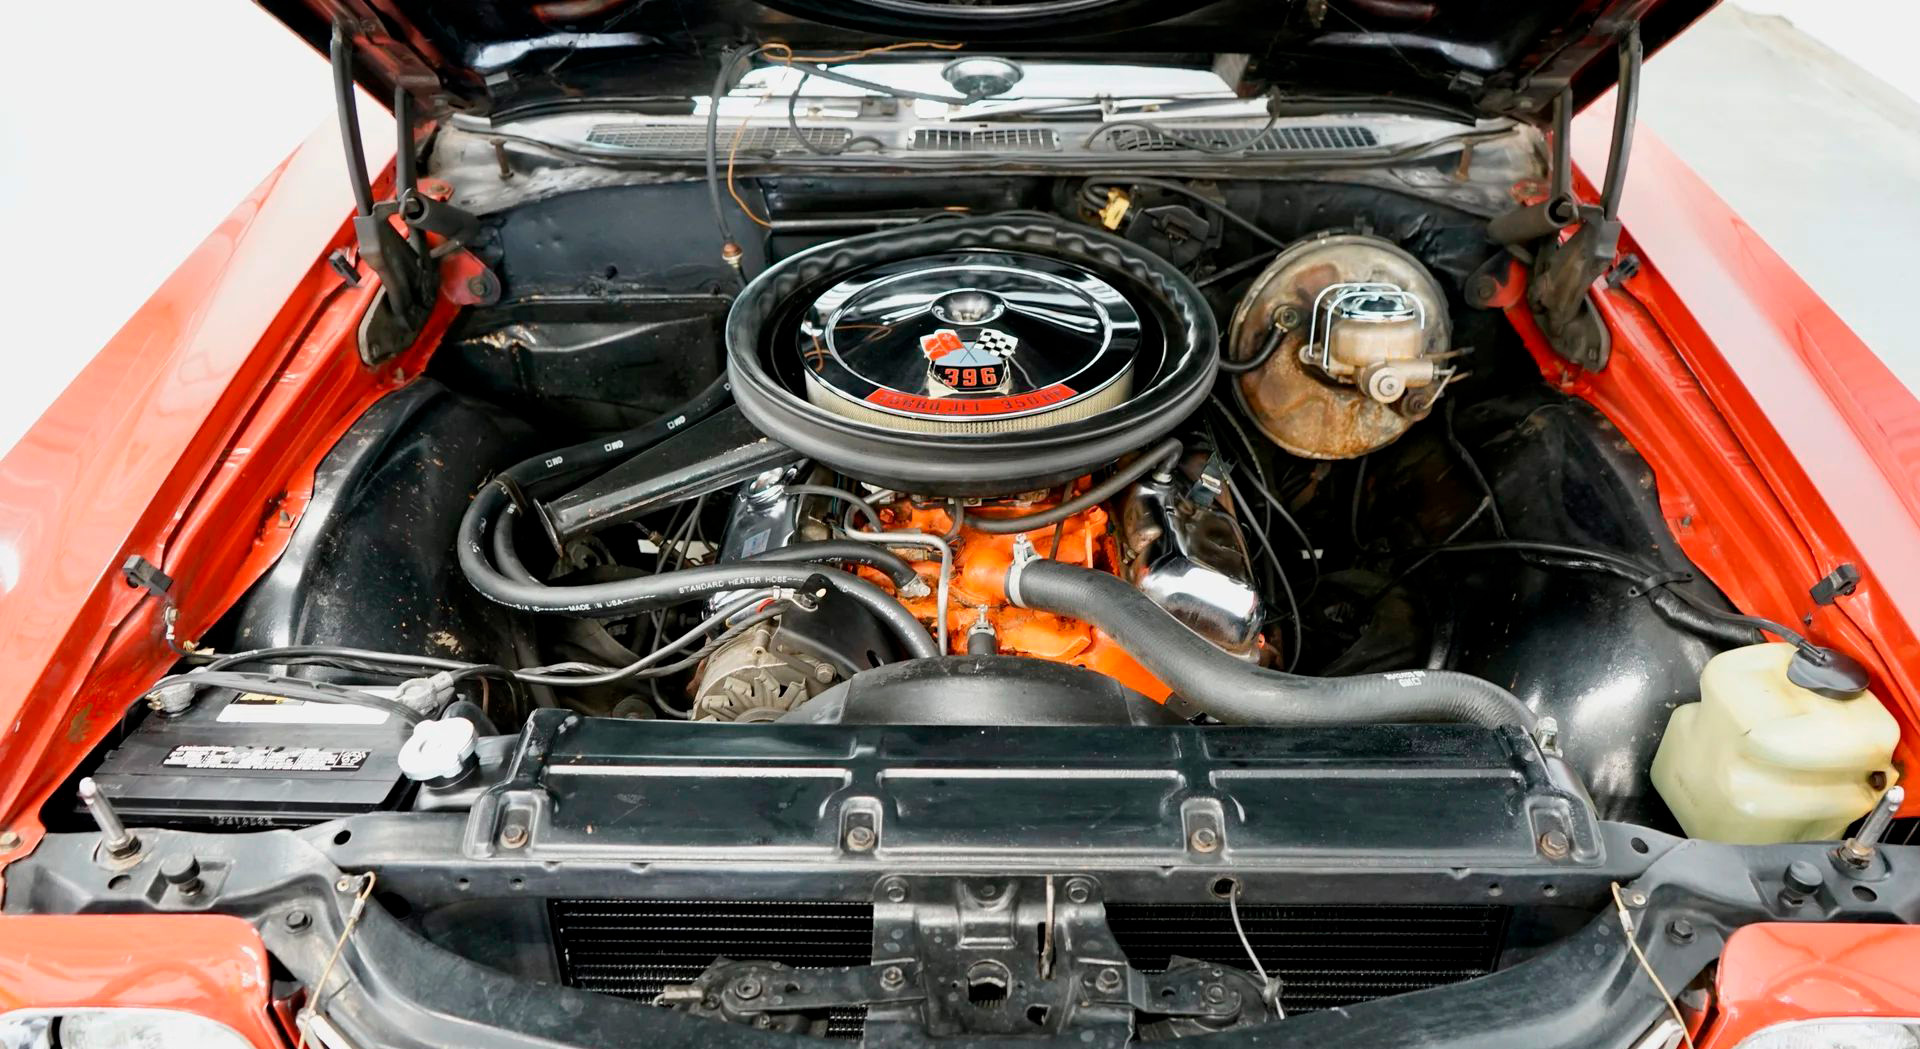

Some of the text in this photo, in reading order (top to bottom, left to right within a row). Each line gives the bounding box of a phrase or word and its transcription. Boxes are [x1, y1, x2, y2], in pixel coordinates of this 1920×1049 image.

[944, 367, 997, 387] 396
[678, 575, 787, 594] STANDARD HEATER HOSE
[568, 602, 592, 612] MADE
[605, 599, 624, 608] USA
